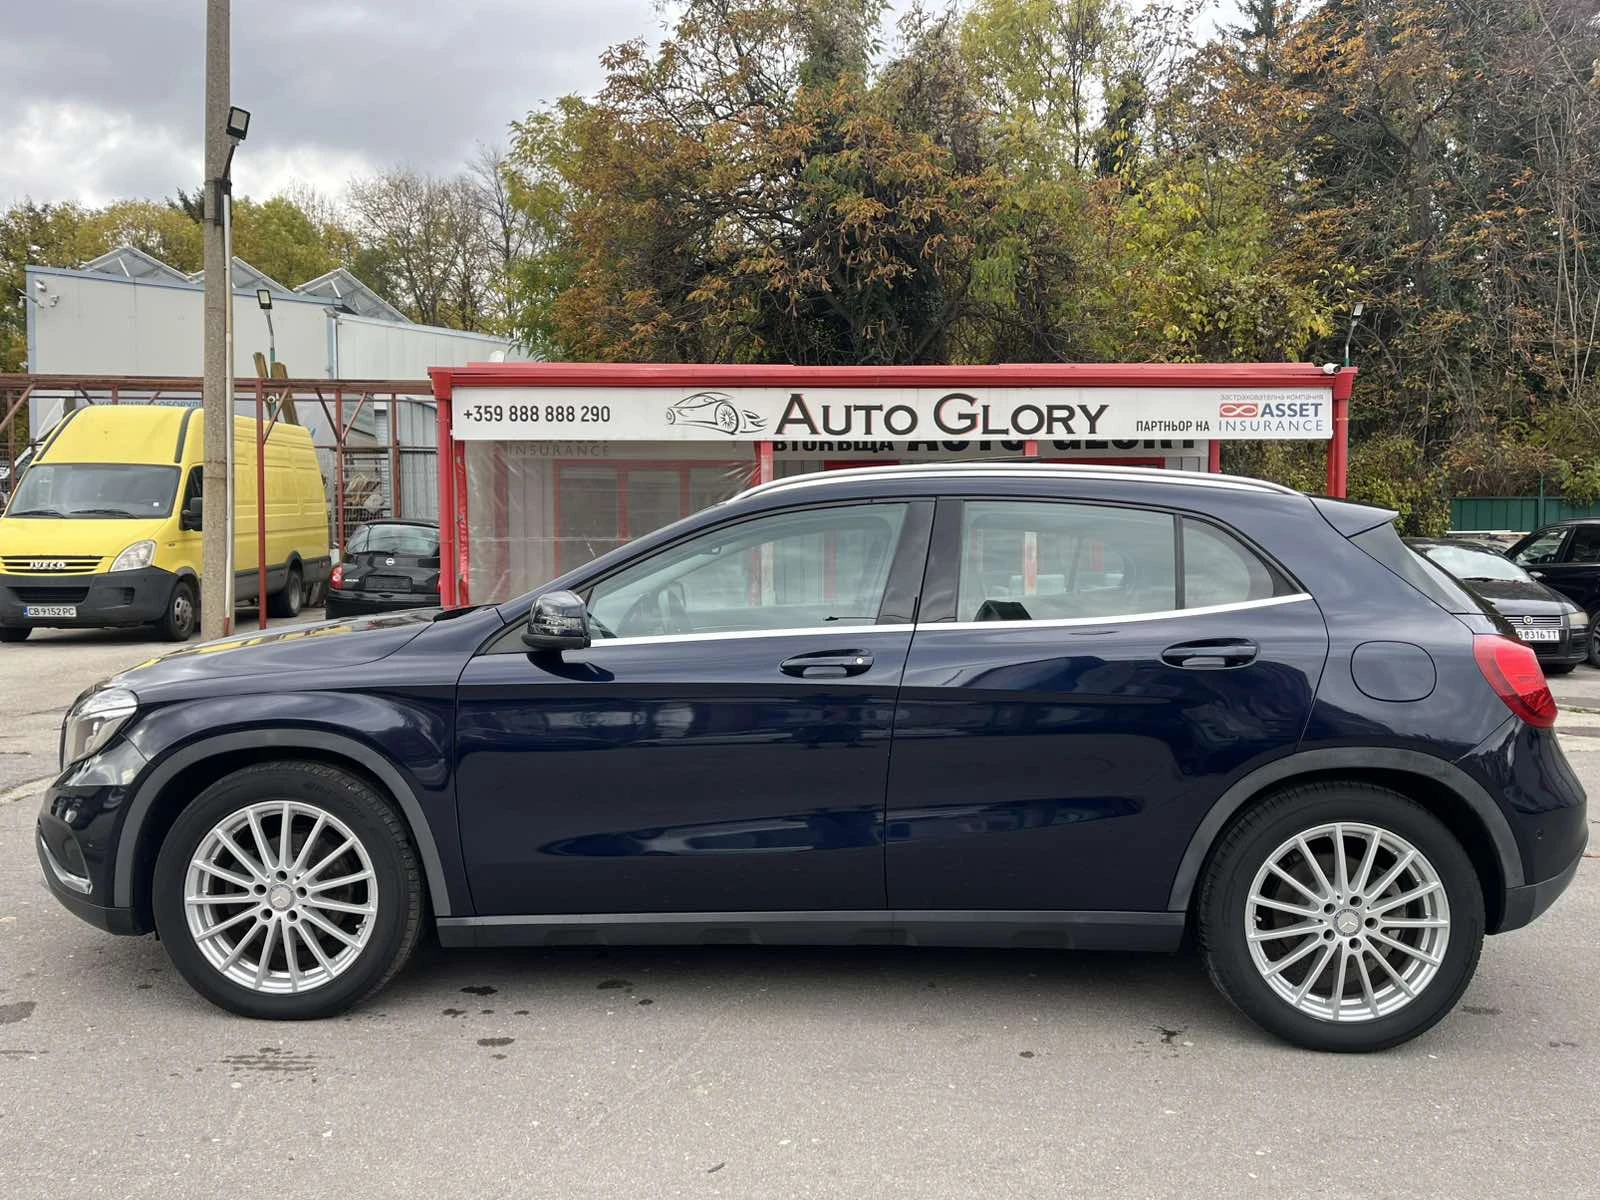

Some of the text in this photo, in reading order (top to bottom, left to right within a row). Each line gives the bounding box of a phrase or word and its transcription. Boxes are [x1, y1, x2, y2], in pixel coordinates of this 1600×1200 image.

[463, 405, 611, 422] +359 888 888 290
[1260, 403, 1323, 418] ASSET
[1136, 420, 1210, 432] ПАРТНЬОР НА
[1218, 420, 1323, 432] INSURANCE
[507, 445, 609, 457] INSURANCE
[29, 562, 67, 570] IVECO
